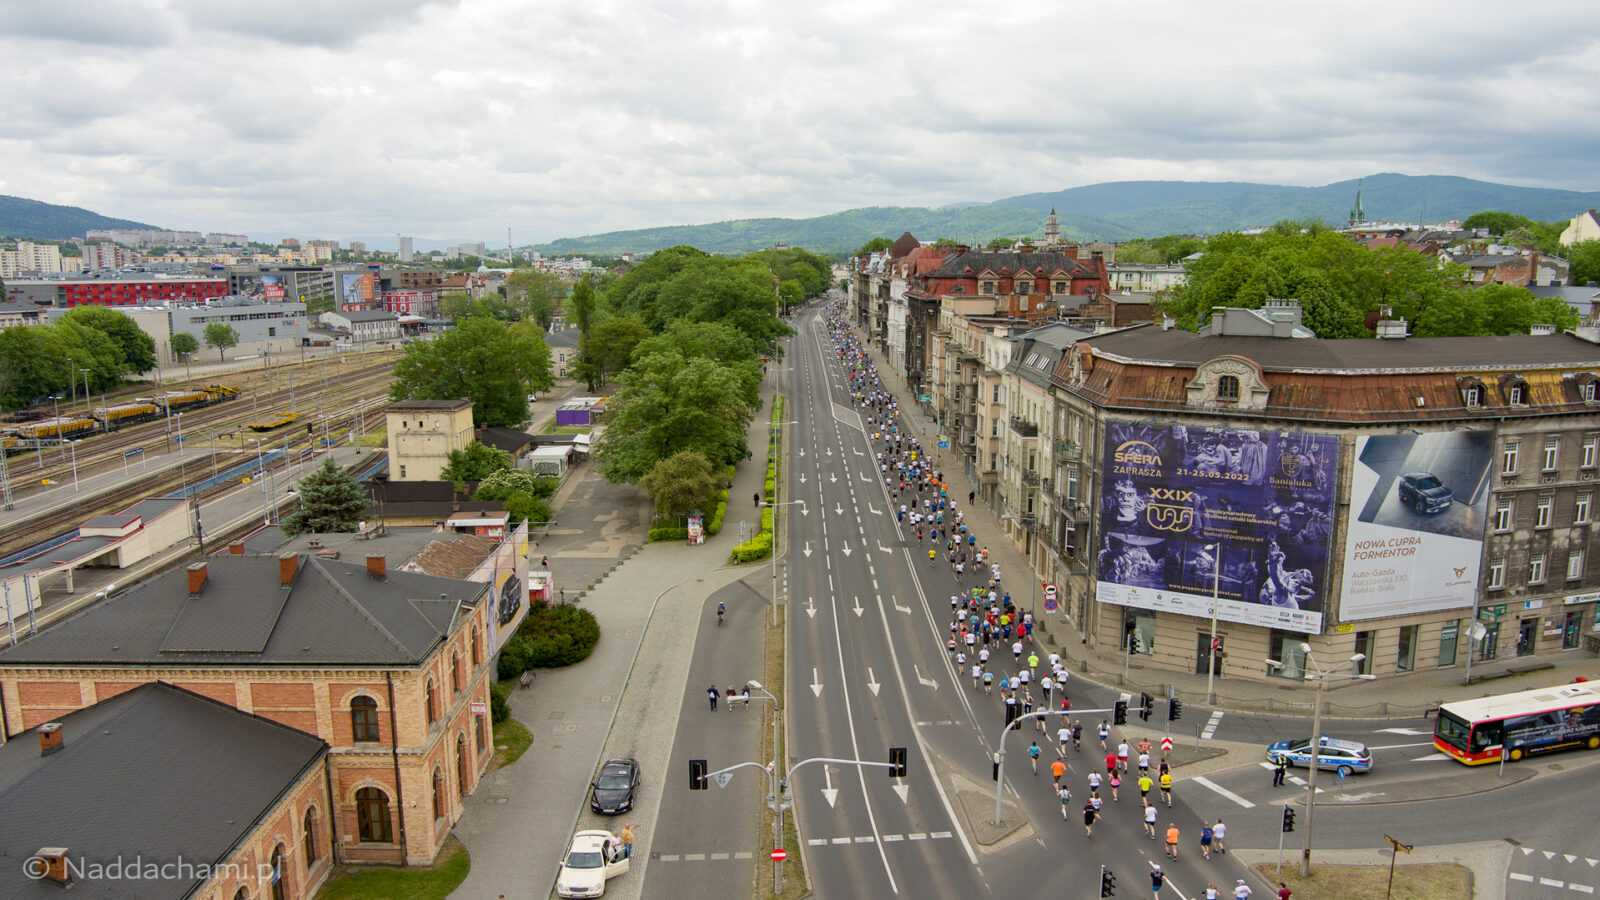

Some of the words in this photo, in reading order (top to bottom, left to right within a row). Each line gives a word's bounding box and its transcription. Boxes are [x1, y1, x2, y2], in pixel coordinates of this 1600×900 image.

[1114, 452, 1163, 466] SFERA
[1113, 465, 1162, 478] ZAPRASZA
[1150, 487, 1193, 502] XXIX
[1354, 539, 1386, 550] NOWA
[1388, 536, 1422, 548] CUPRA
[1353, 546, 1417, 561] FORMENTOR
